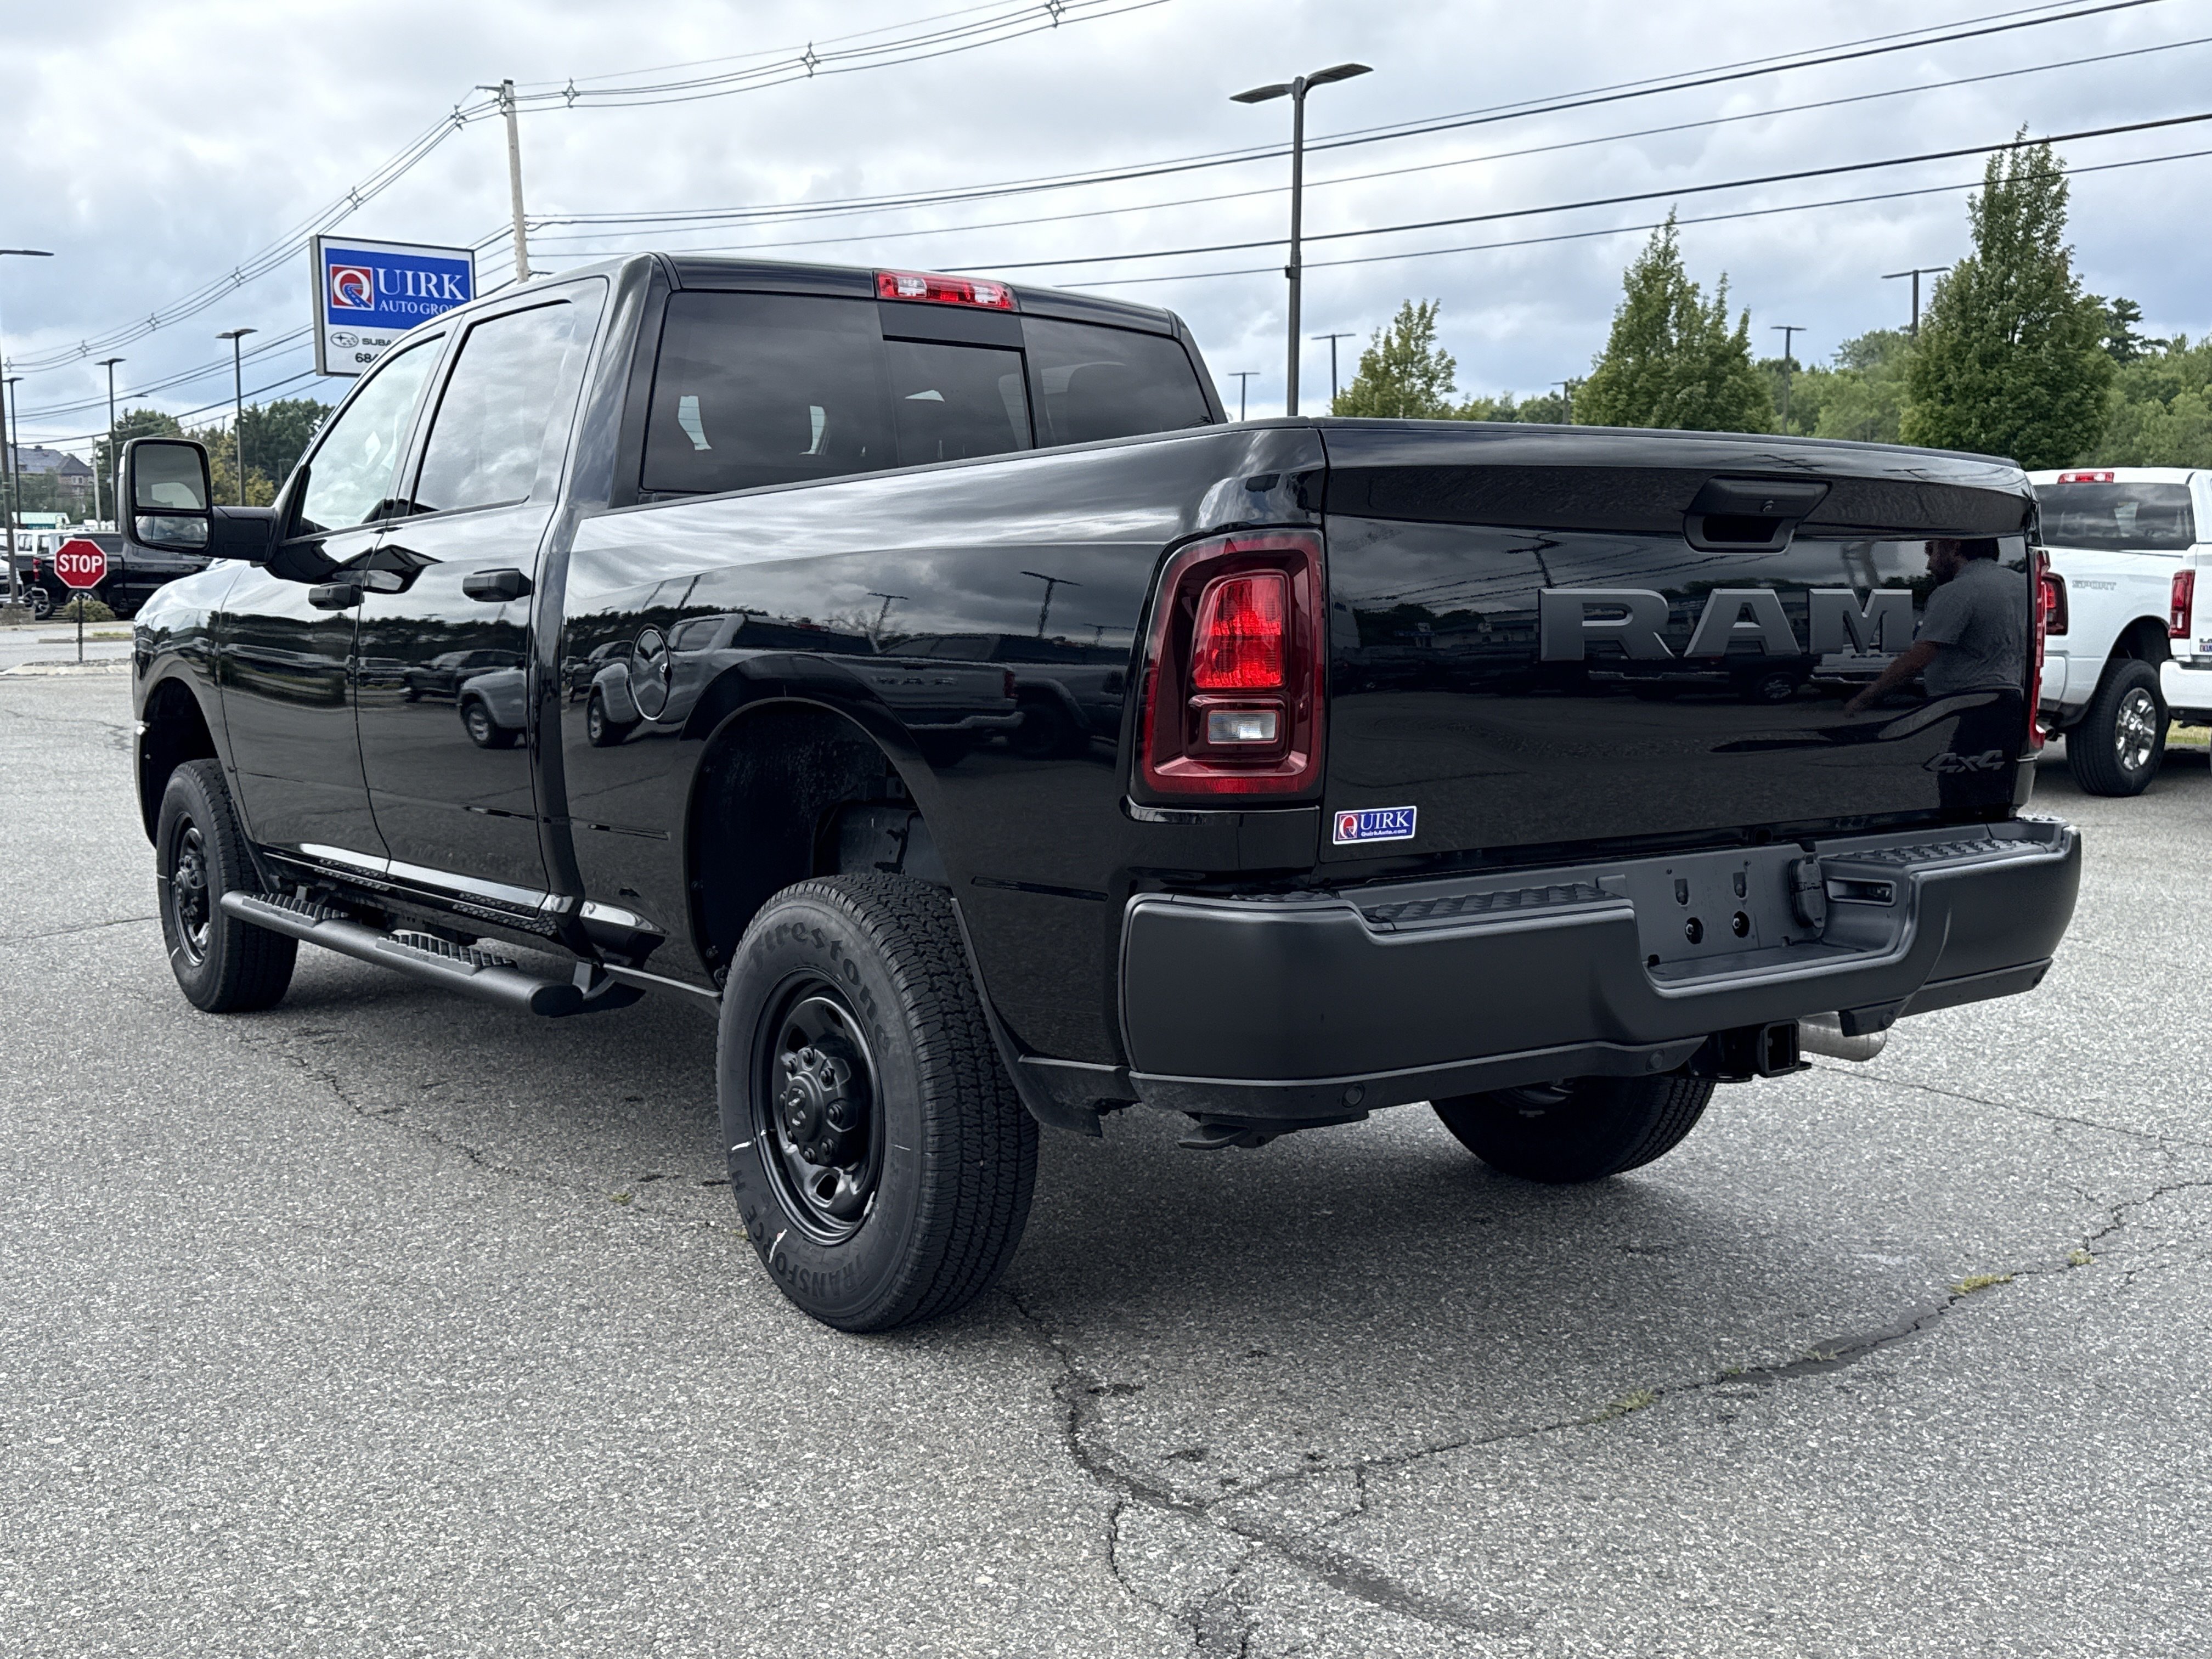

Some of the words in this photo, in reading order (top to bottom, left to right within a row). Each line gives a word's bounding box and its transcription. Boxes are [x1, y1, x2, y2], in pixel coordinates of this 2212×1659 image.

[334, 268, 467, 308] QUIRK
[379, 300, 418, 314] AUTO
[419, 302, 457, 315] GRO
[362, 338, 392, 346] SUBA
[59, 554, 103, 573] STOP
[2072, 579, 2117, 590] SPORT
[1540, 588, 1913, 660] RAM
[1339, 811, 1410, 838] QUIRK
[749, 922, 891, 1058] Firestone
